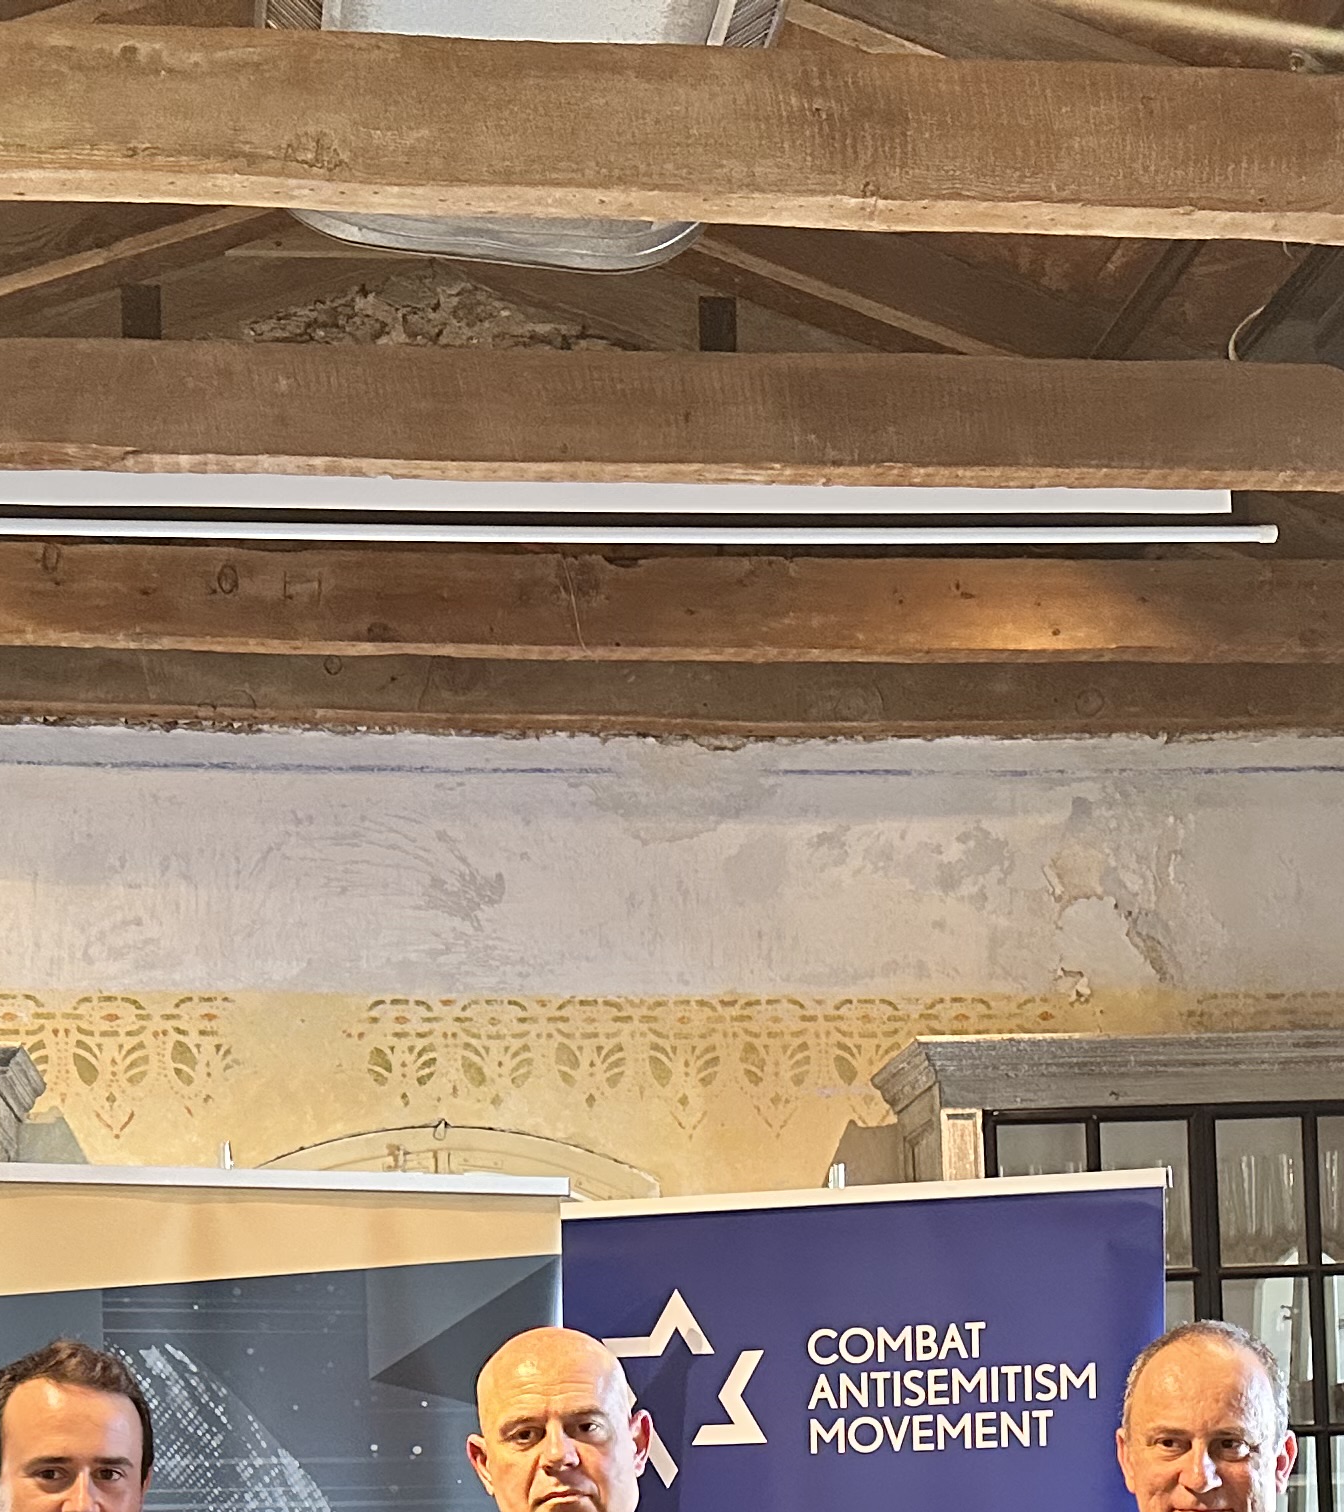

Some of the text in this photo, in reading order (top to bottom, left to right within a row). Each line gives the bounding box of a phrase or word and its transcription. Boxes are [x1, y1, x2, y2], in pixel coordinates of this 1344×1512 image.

[807, 1320, 987, 1366] COMBAT
[807, 1362, 1098, 1410] ANTISEMITISM
[808, 1409, 1055, 1455] MOVEMENT
